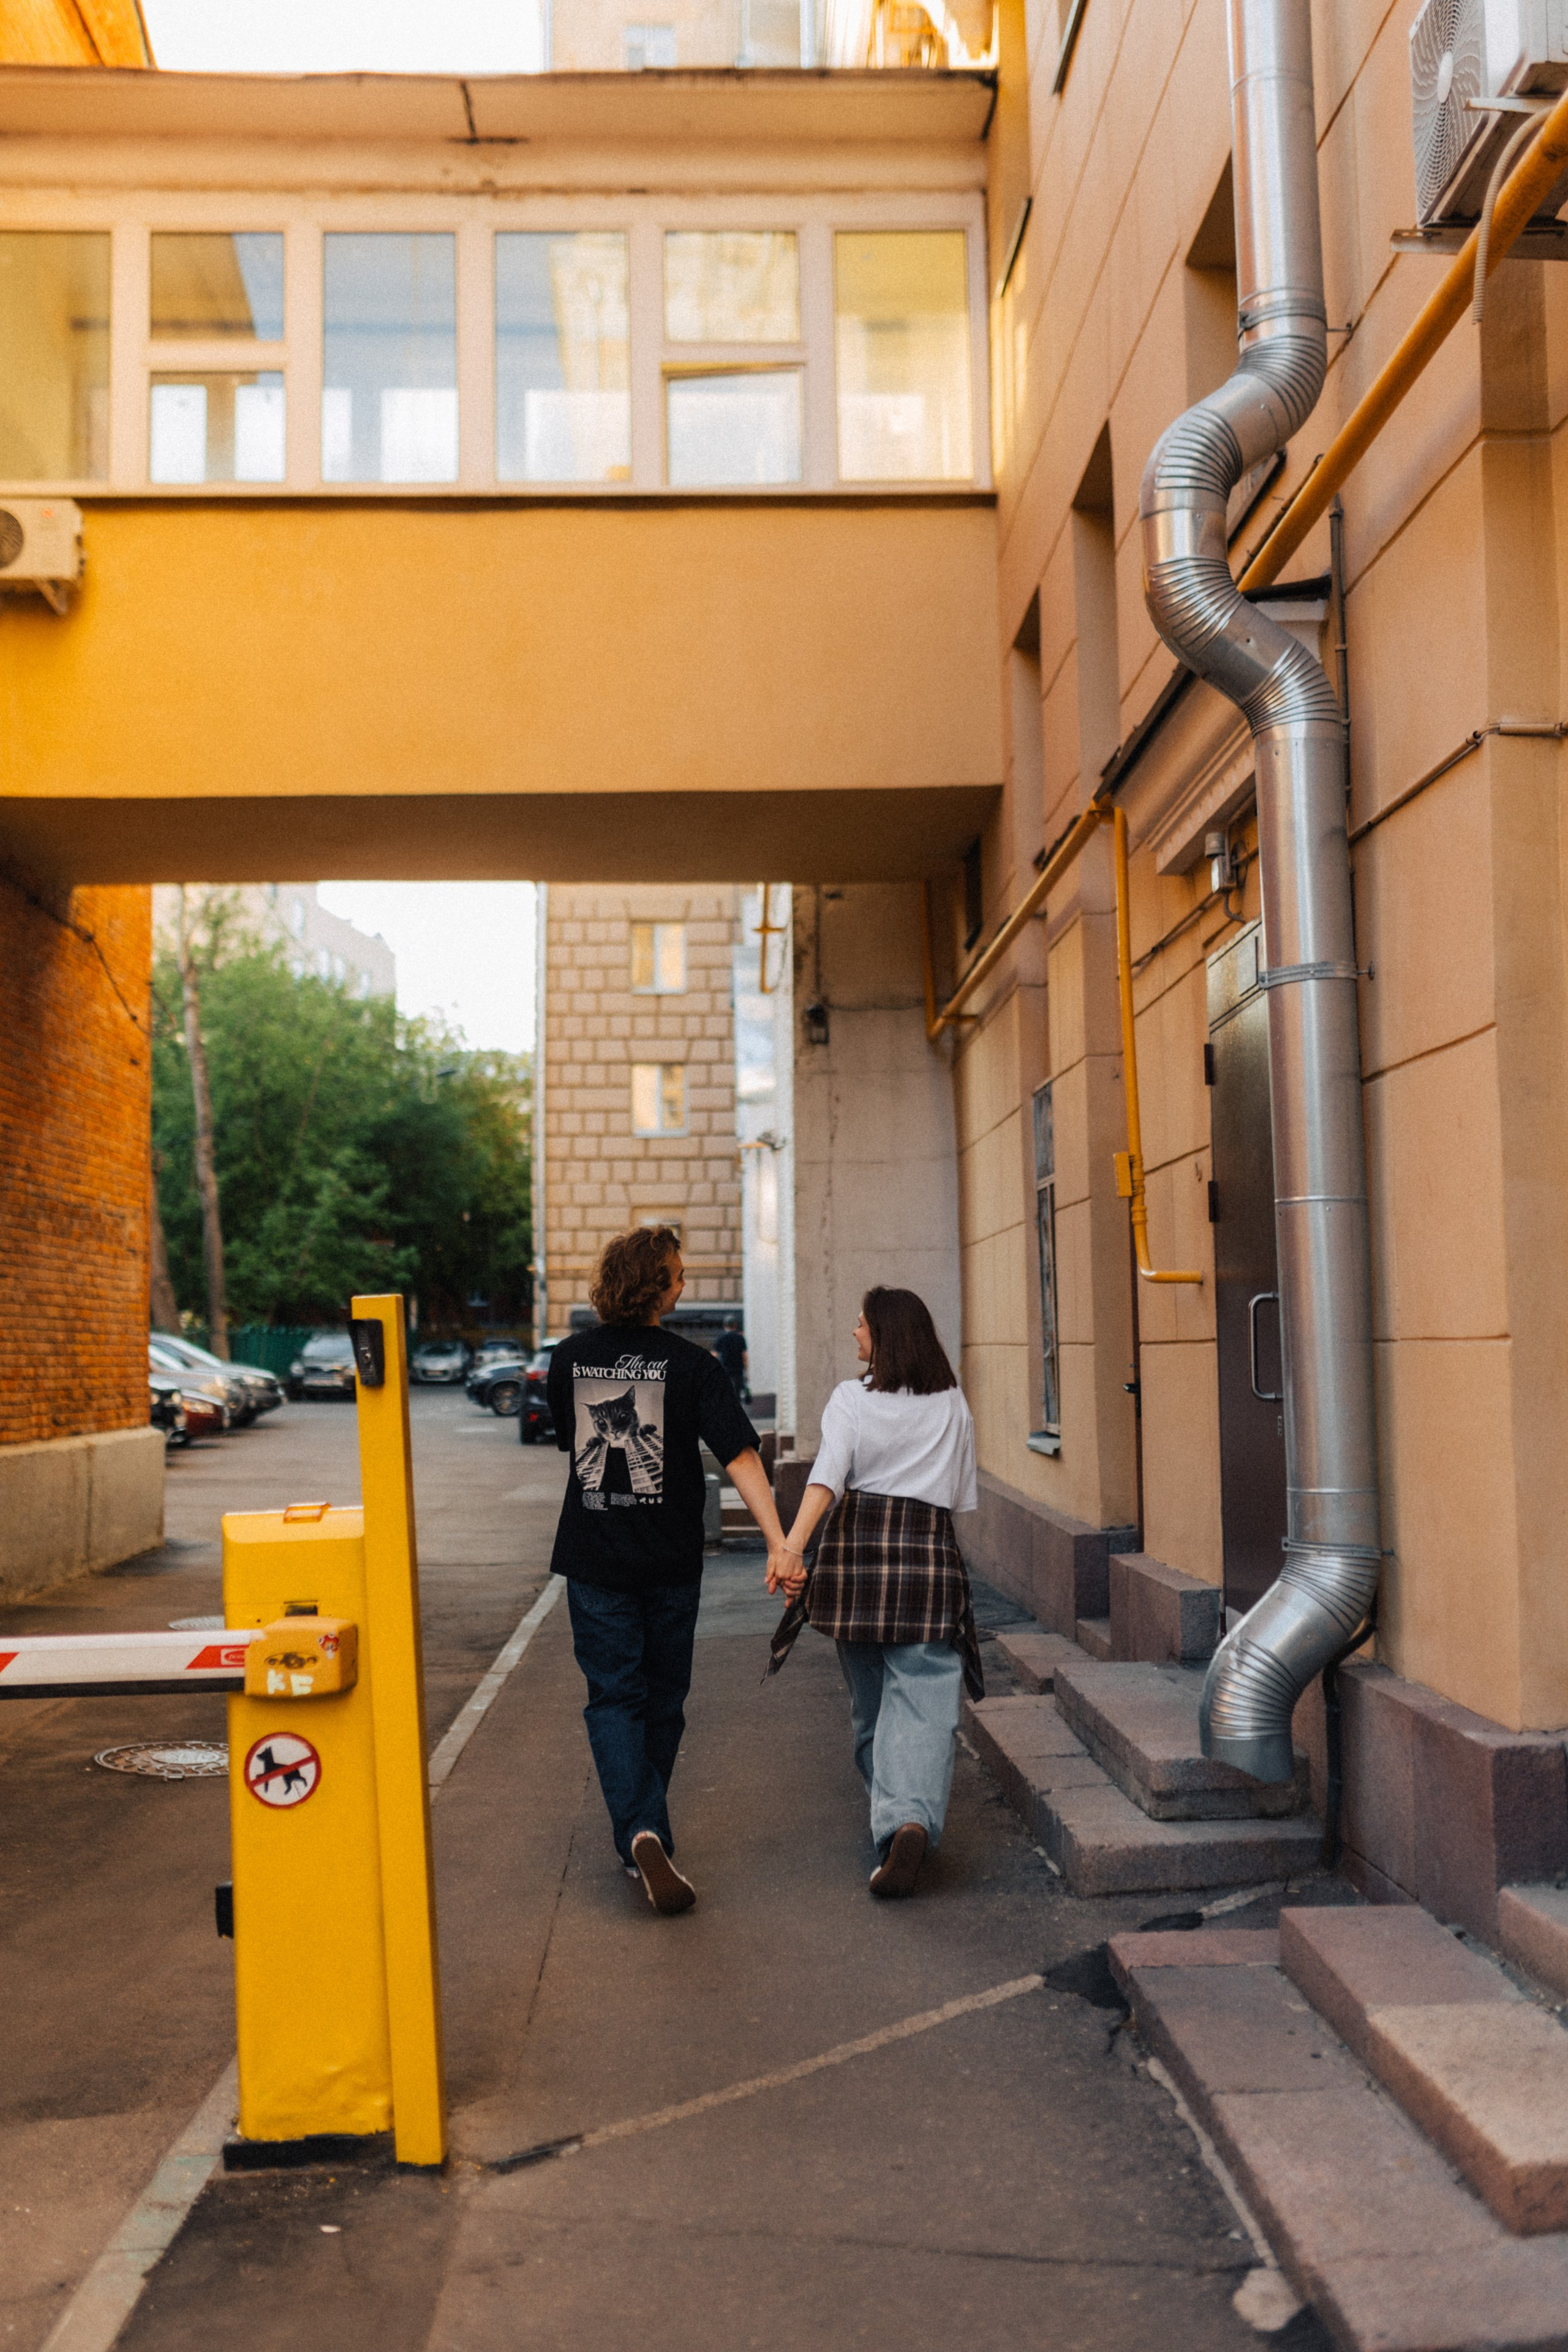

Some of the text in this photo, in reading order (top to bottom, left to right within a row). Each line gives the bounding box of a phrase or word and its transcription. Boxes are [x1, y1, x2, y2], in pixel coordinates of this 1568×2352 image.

[615, 1354, 669, 1370] The cat
[581, 1366, 642, 1379] WATCHING
[643, 1369, 667, 1381] YOU
